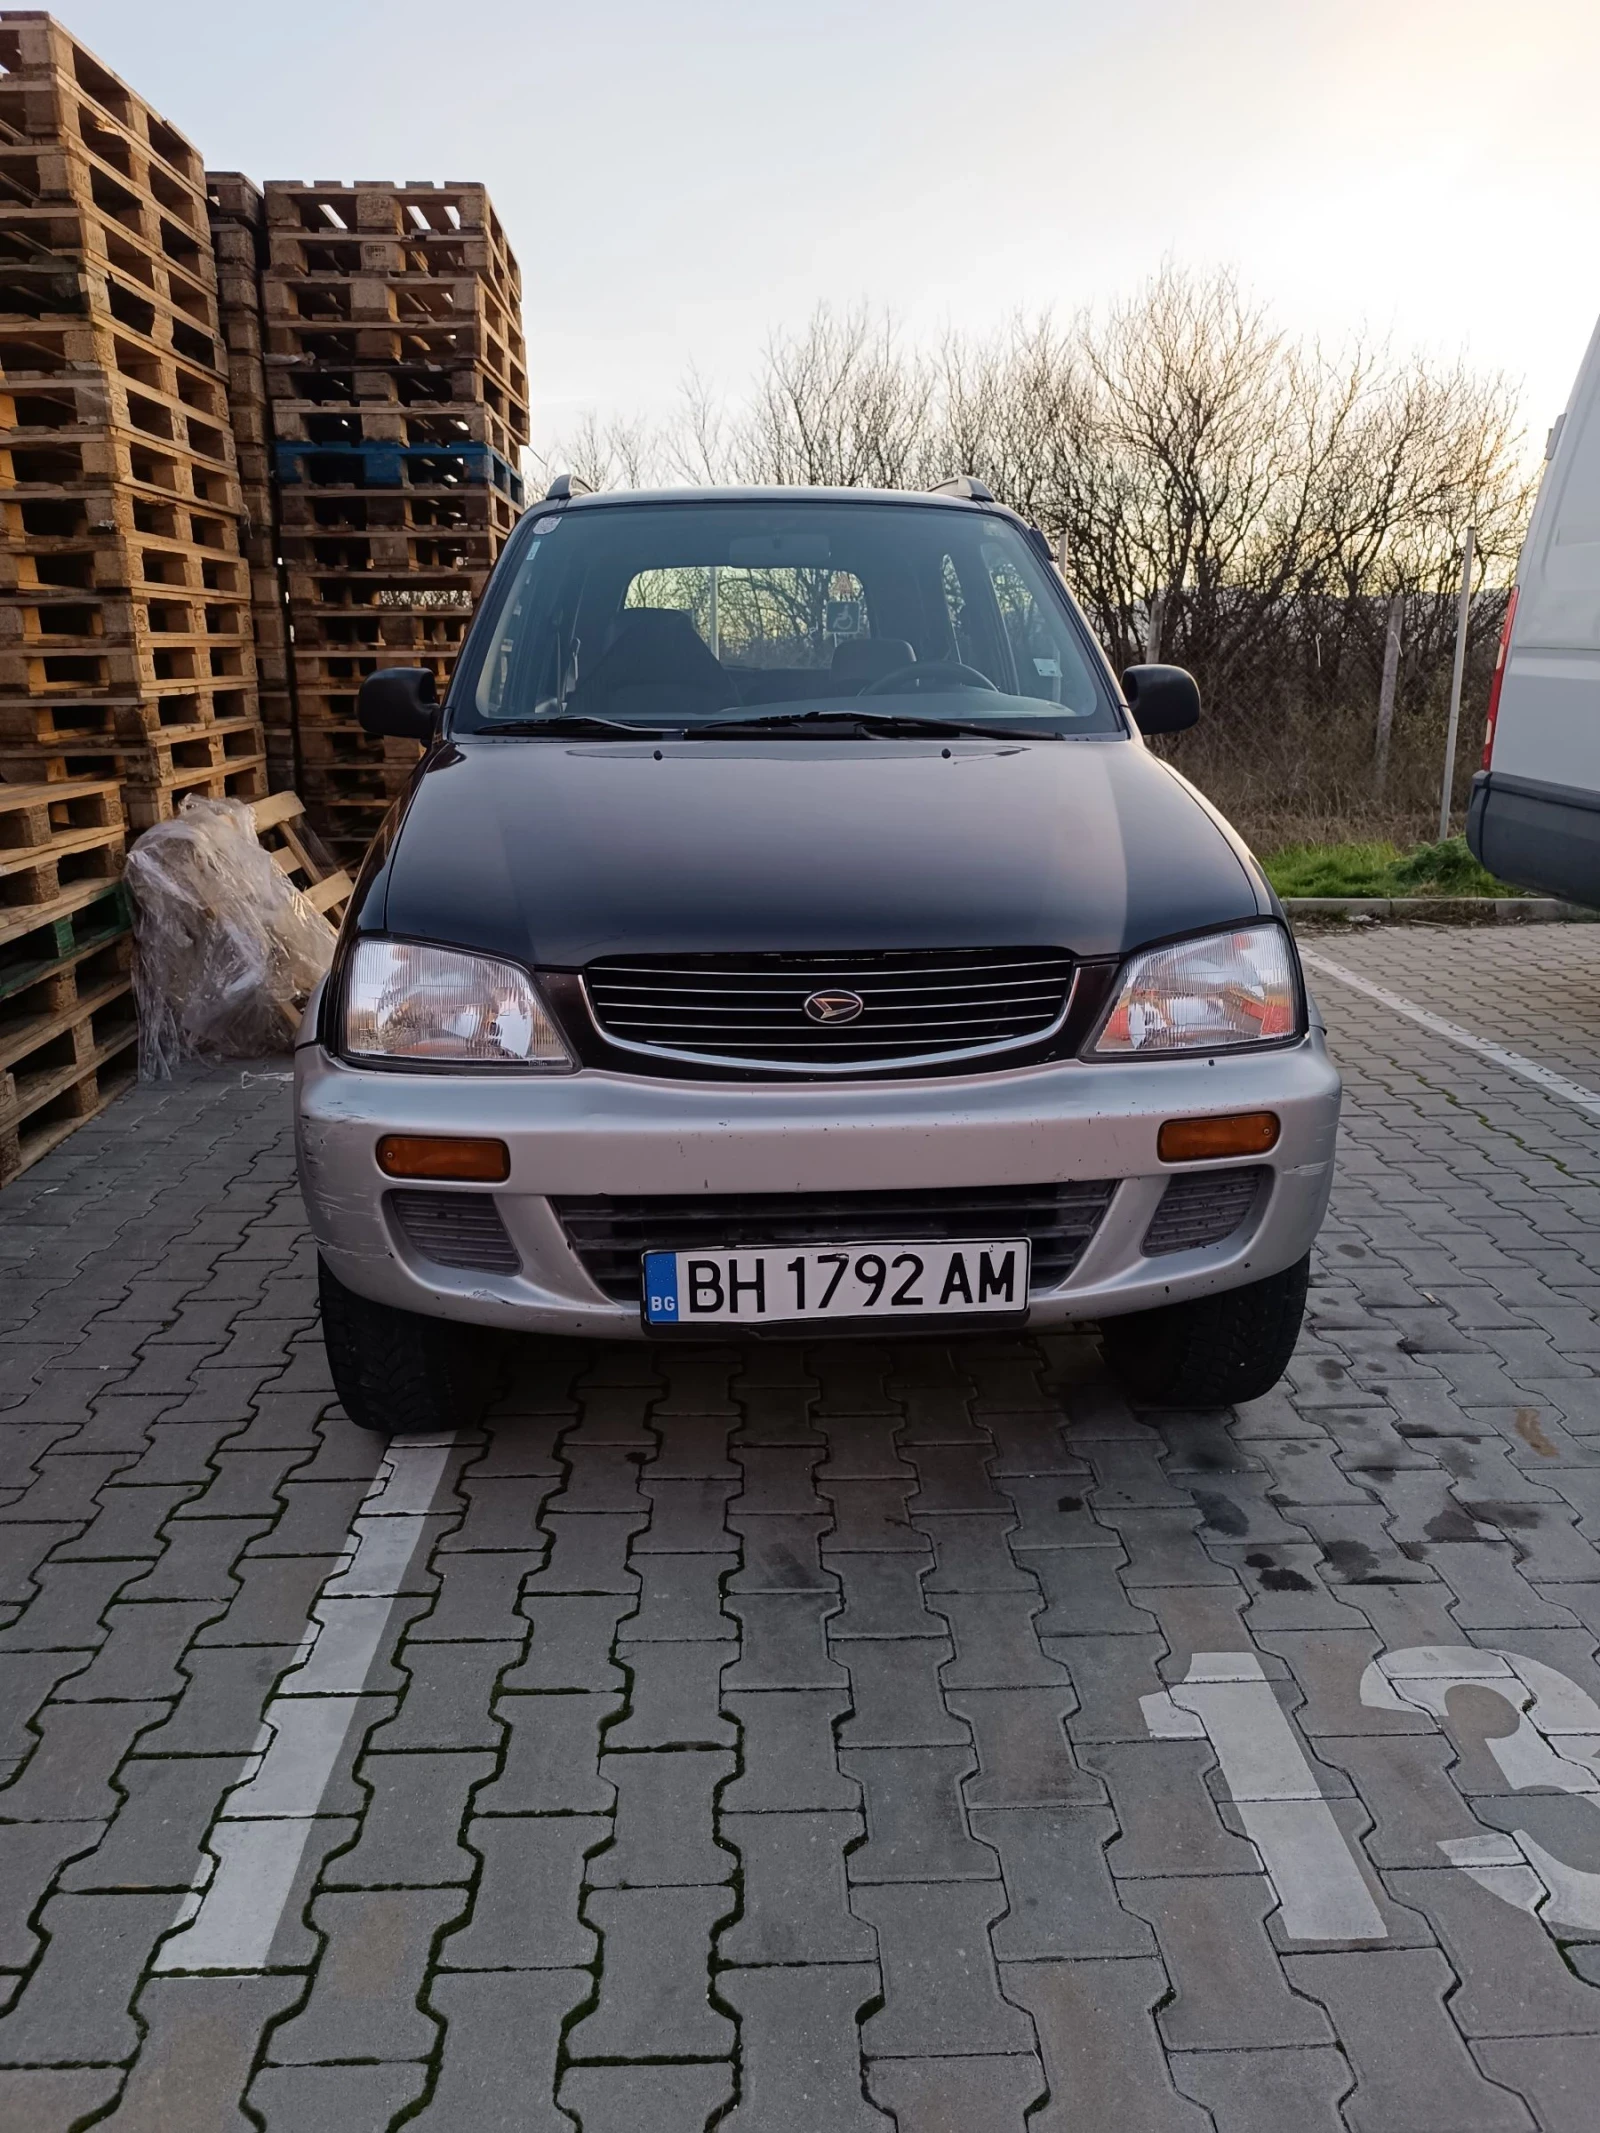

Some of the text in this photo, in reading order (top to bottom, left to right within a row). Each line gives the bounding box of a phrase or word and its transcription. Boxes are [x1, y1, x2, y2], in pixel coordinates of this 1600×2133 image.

[688, 1251, 1015, 1313] BH 1792 AM
[651, 1296, 675, 1311] BG
